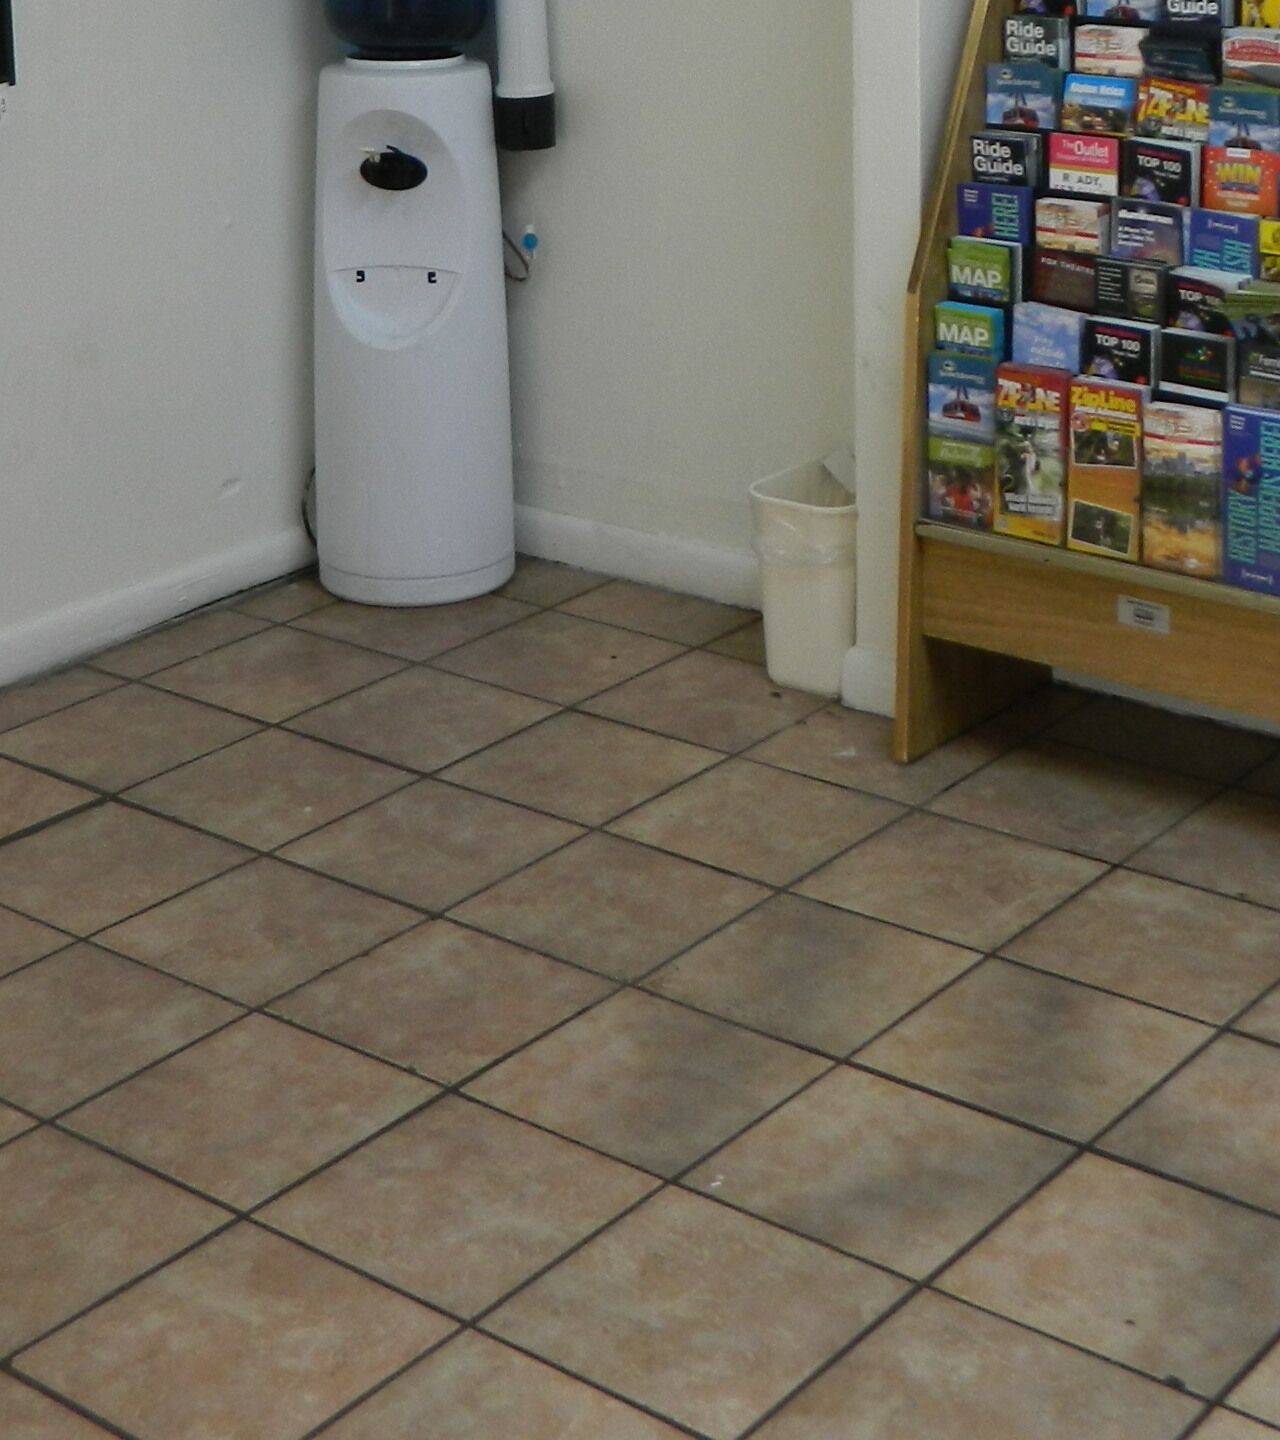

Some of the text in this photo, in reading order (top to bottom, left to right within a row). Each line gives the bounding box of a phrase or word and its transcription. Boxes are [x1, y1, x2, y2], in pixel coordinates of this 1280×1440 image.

[1006, 20, 1045, 39] Ride
[1006, 37, 1057, 57] Guide
[973, 139, 1011, 158] Ride
[1074, 140, 1109, 158] Outlet
[974, 156, 1024, 176] Guide
[1137, 155, 1182, 173] TOP 100
[951, 264, 1002, 289] MAP
[1179, 289, 1202, 302] TOP
[939, 323, 989, 347] MAP
[1096, 334, 1141, 352] TOP 100
[1228, 489, 1257, 564] HISTORY
